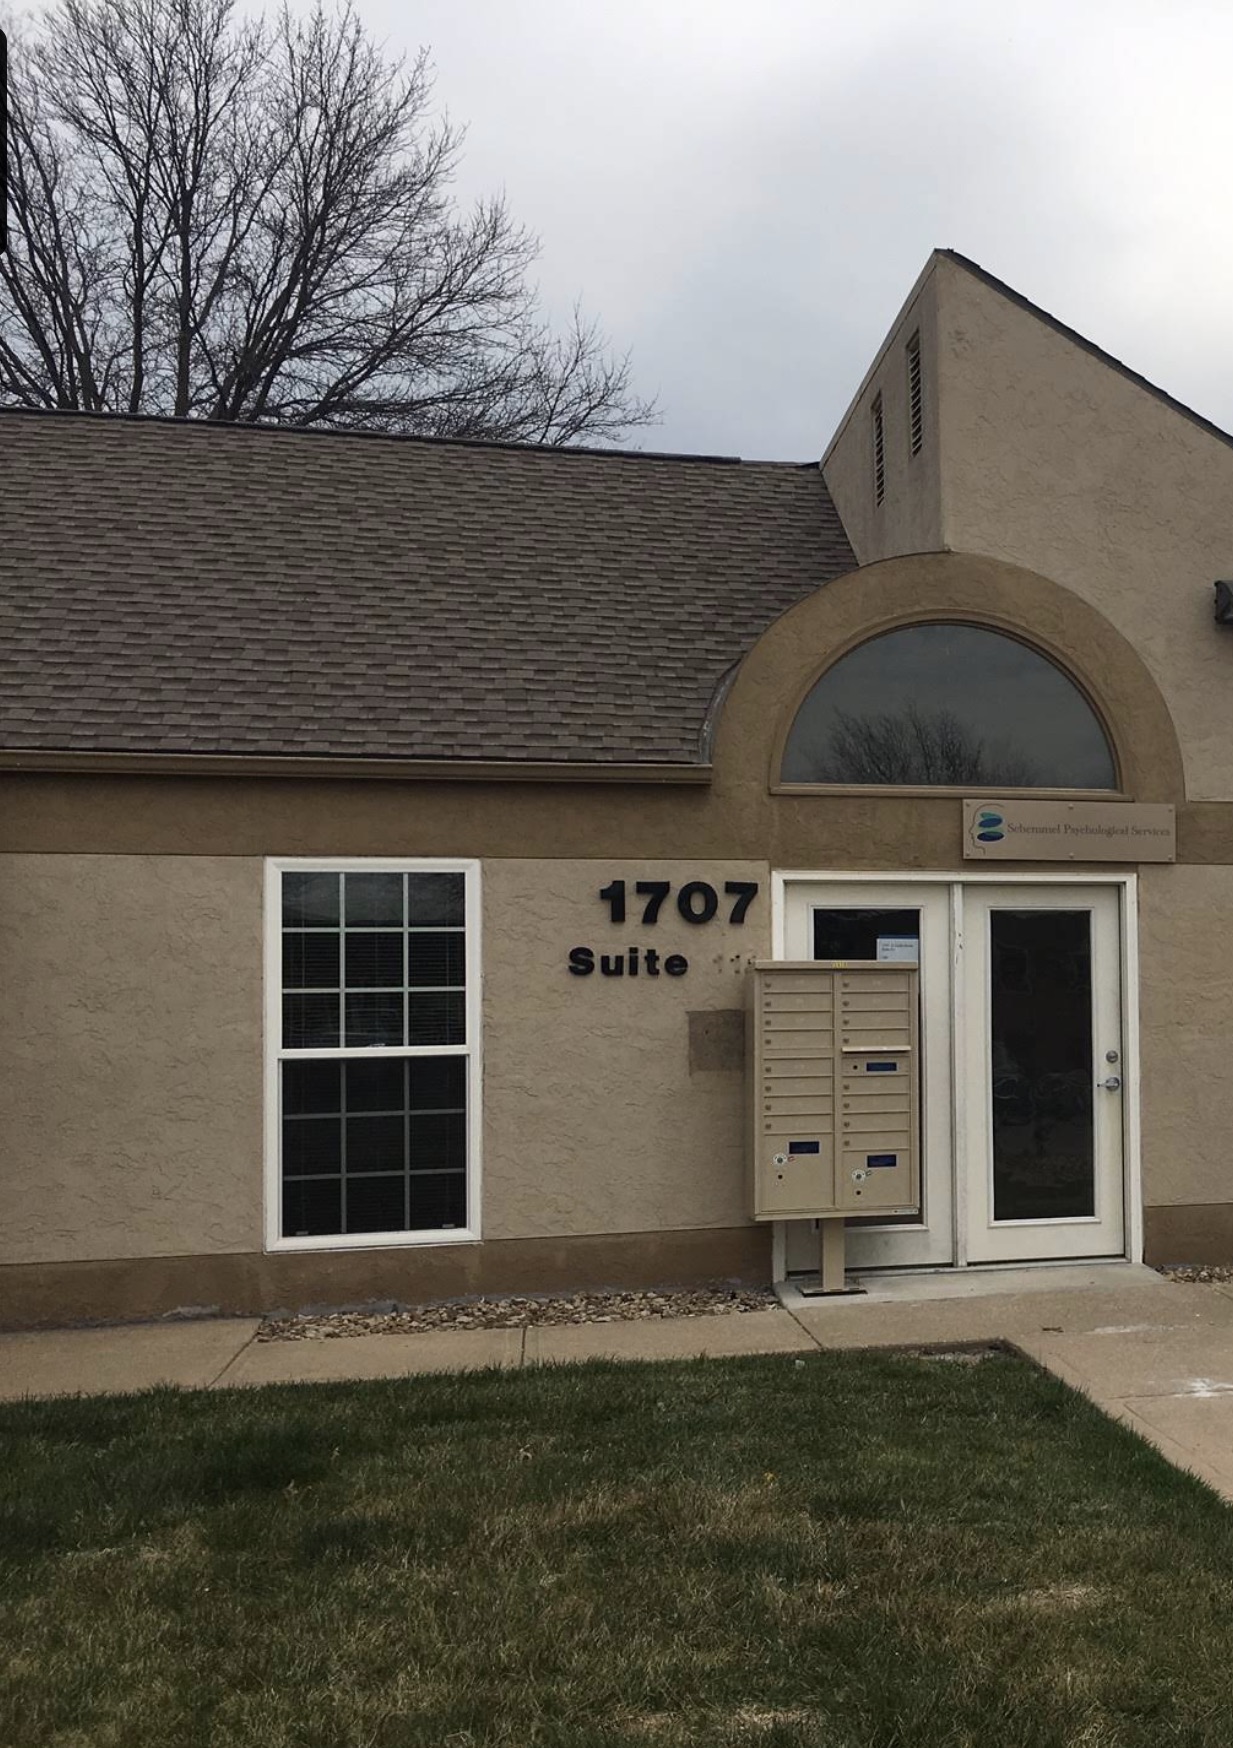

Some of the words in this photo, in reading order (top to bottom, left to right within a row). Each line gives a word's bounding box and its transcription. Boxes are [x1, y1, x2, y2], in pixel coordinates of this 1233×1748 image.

[1064, 824, 1129, 838] Psychological
[1131, 826, 1171, 837] Services
[600, 880, 759, 924] 1707
[569, 947, 688, 976] Suite
